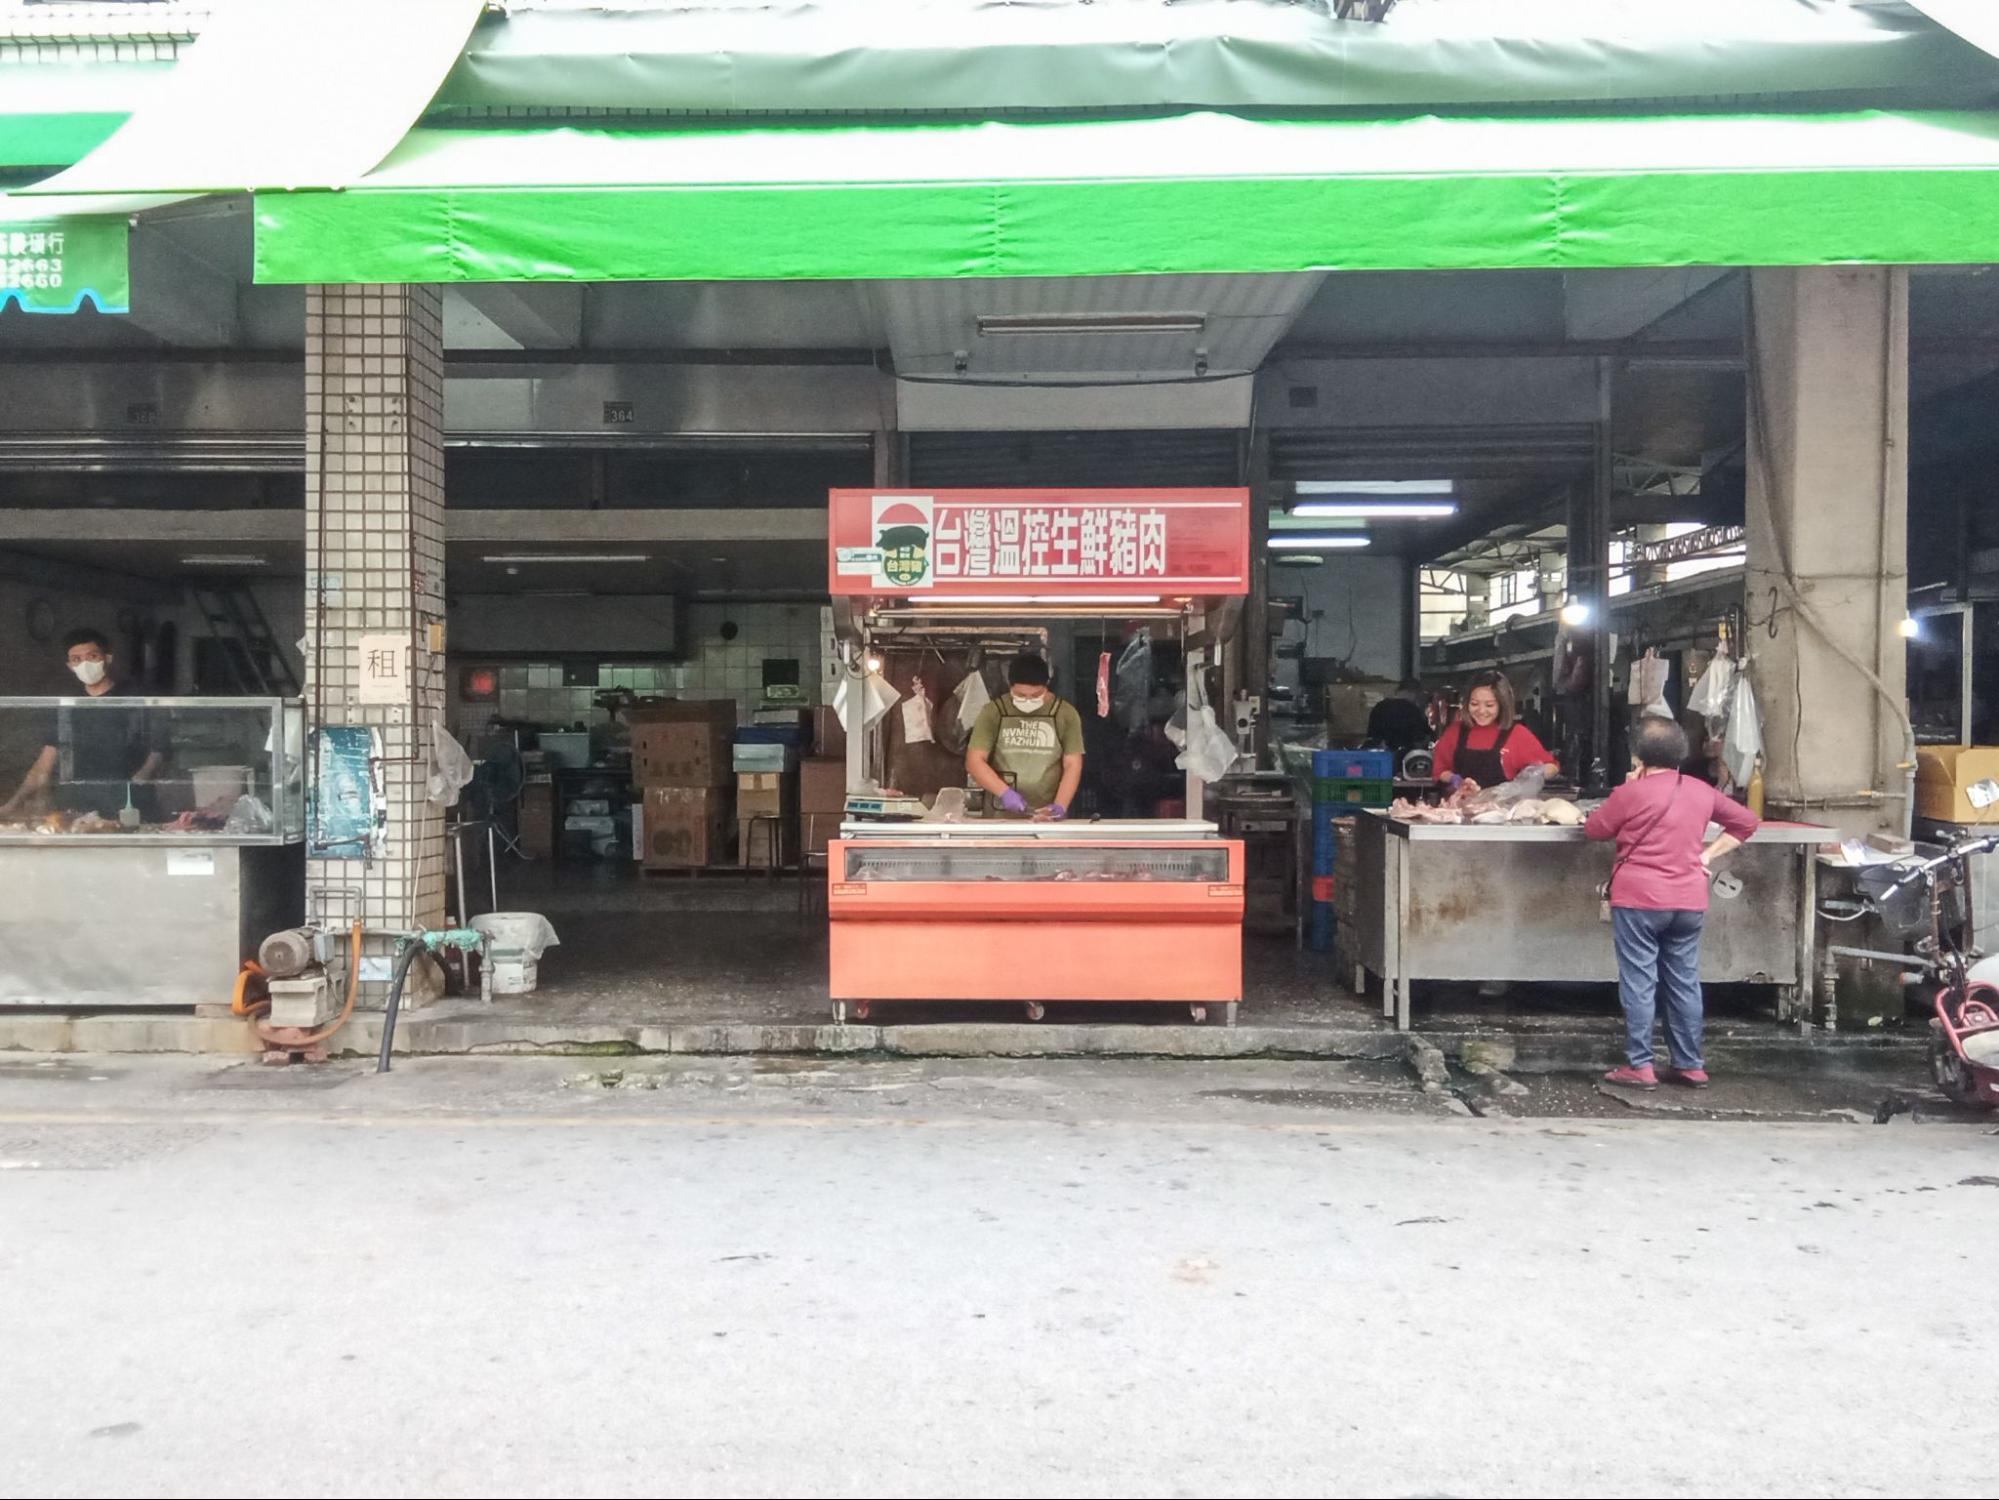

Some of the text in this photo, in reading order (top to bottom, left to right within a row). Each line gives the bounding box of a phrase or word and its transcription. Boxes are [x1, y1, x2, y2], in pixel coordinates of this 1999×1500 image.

[611, 409, 633, 422] 364
[367, 649, 398, 679] 租
[1019, 720, 1039, 729] THE
